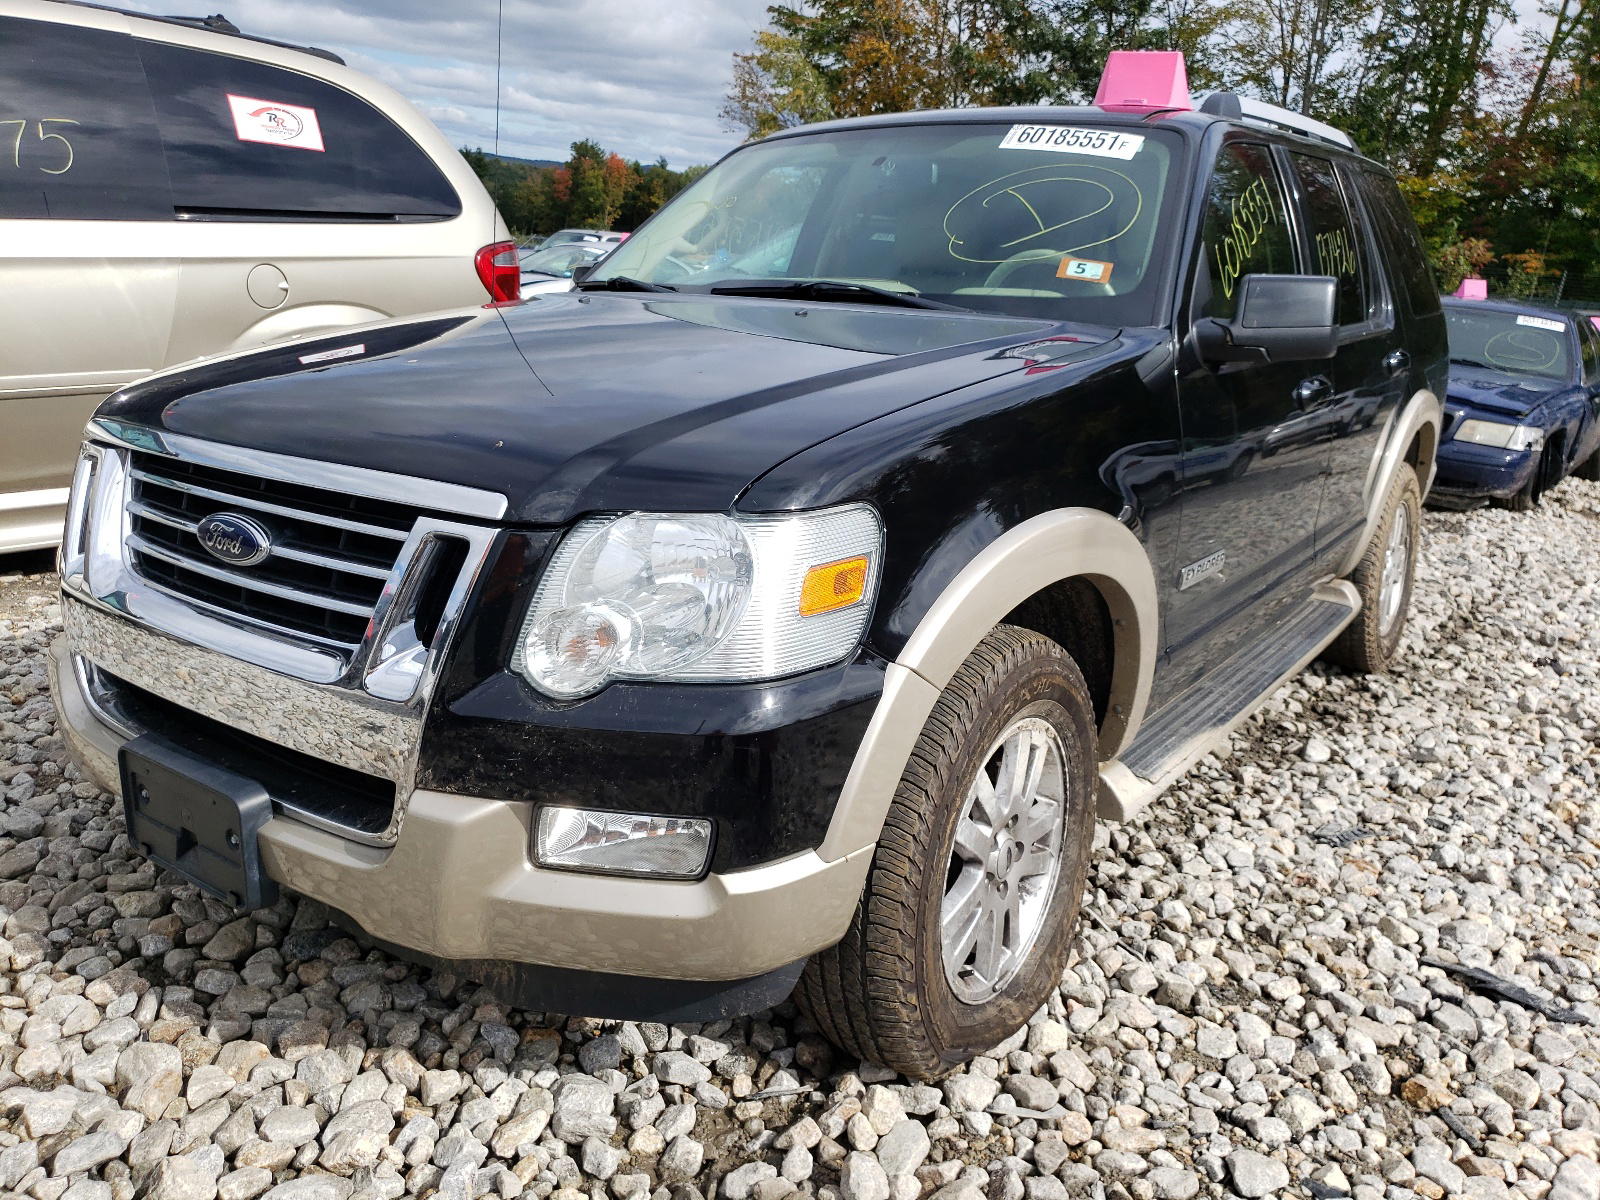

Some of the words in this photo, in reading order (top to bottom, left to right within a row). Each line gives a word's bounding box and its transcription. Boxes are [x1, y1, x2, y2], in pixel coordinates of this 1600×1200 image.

[1017, 126, 1120, 151] 60185551
[1118, 140, 1129, 151] F
[1073, 262, 1088, 275] 5
[206, 521, 244, 555] Ford
